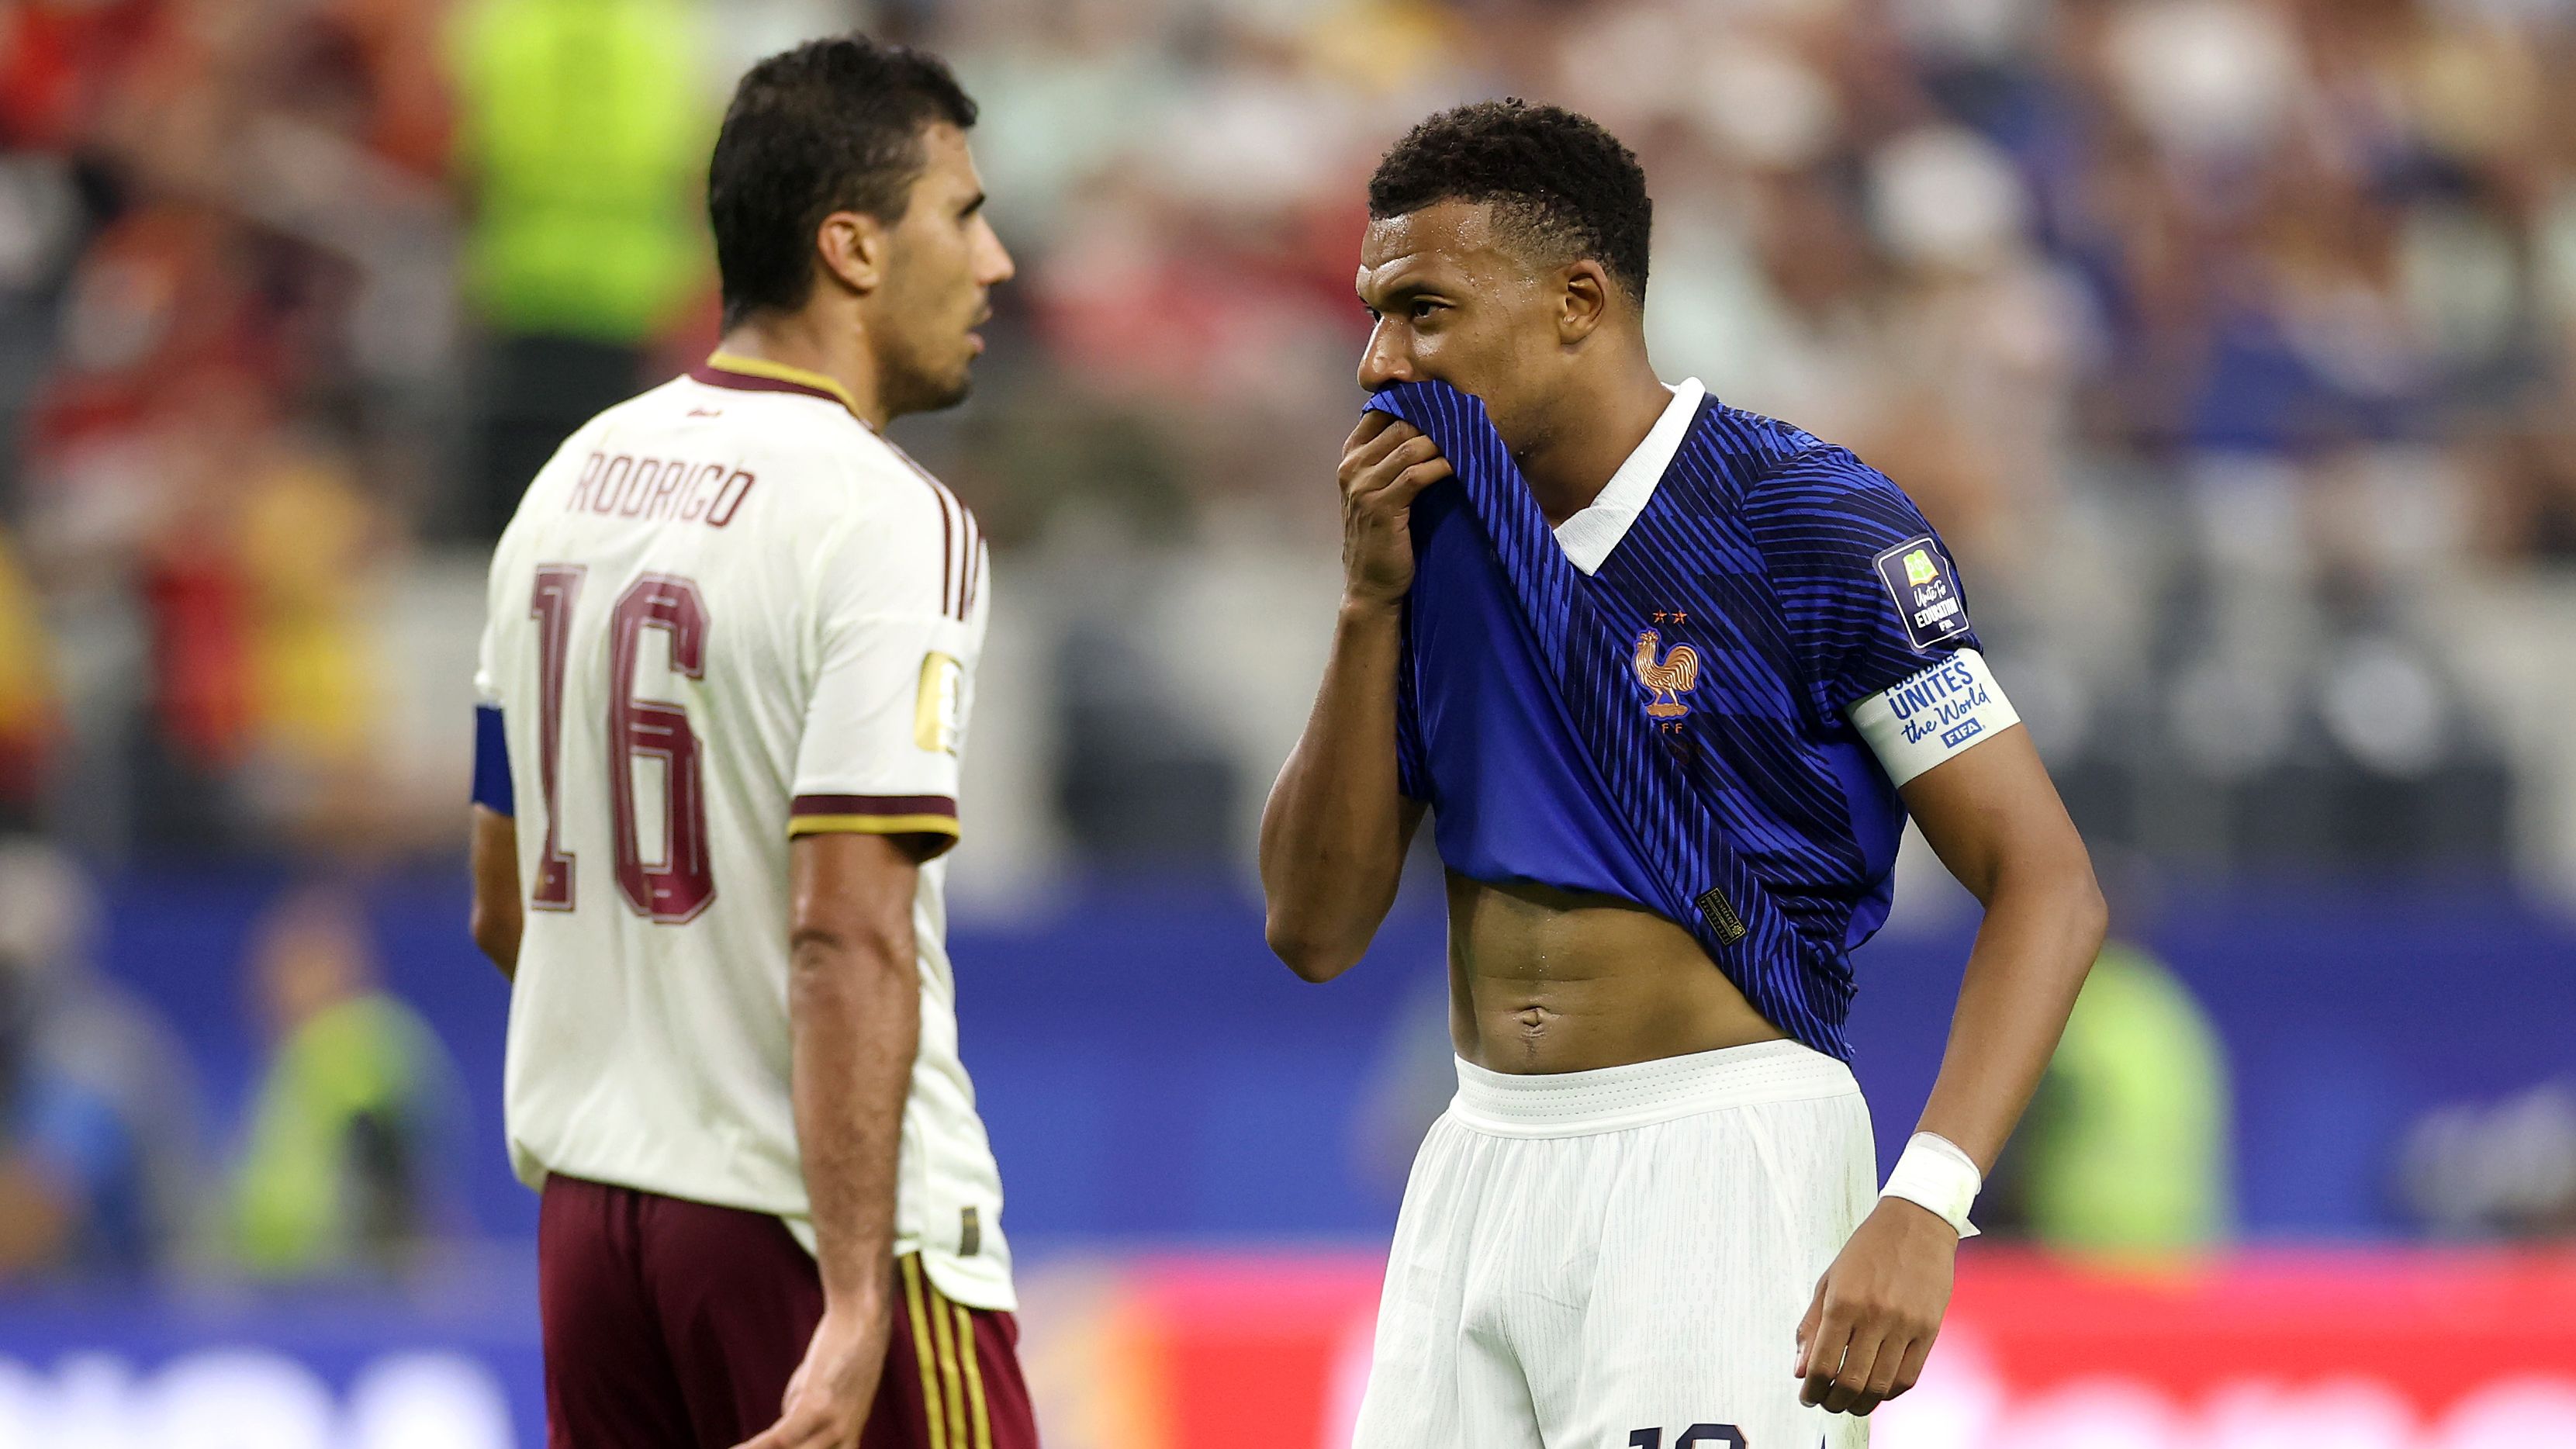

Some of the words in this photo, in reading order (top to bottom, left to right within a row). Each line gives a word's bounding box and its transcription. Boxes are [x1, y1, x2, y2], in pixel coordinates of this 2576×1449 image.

[566, 451, 756, 527] RODRIGO
[1914, 597, 1959, 628] EDUCATION
[1888, 661, 1973, 721] UNITES
[1900, 719, 1938, 744] the
[1934, 683, 1992, 725] World
[531, 563, 716, 925] 16
[1945, 721, 1980, 746] FIFA
